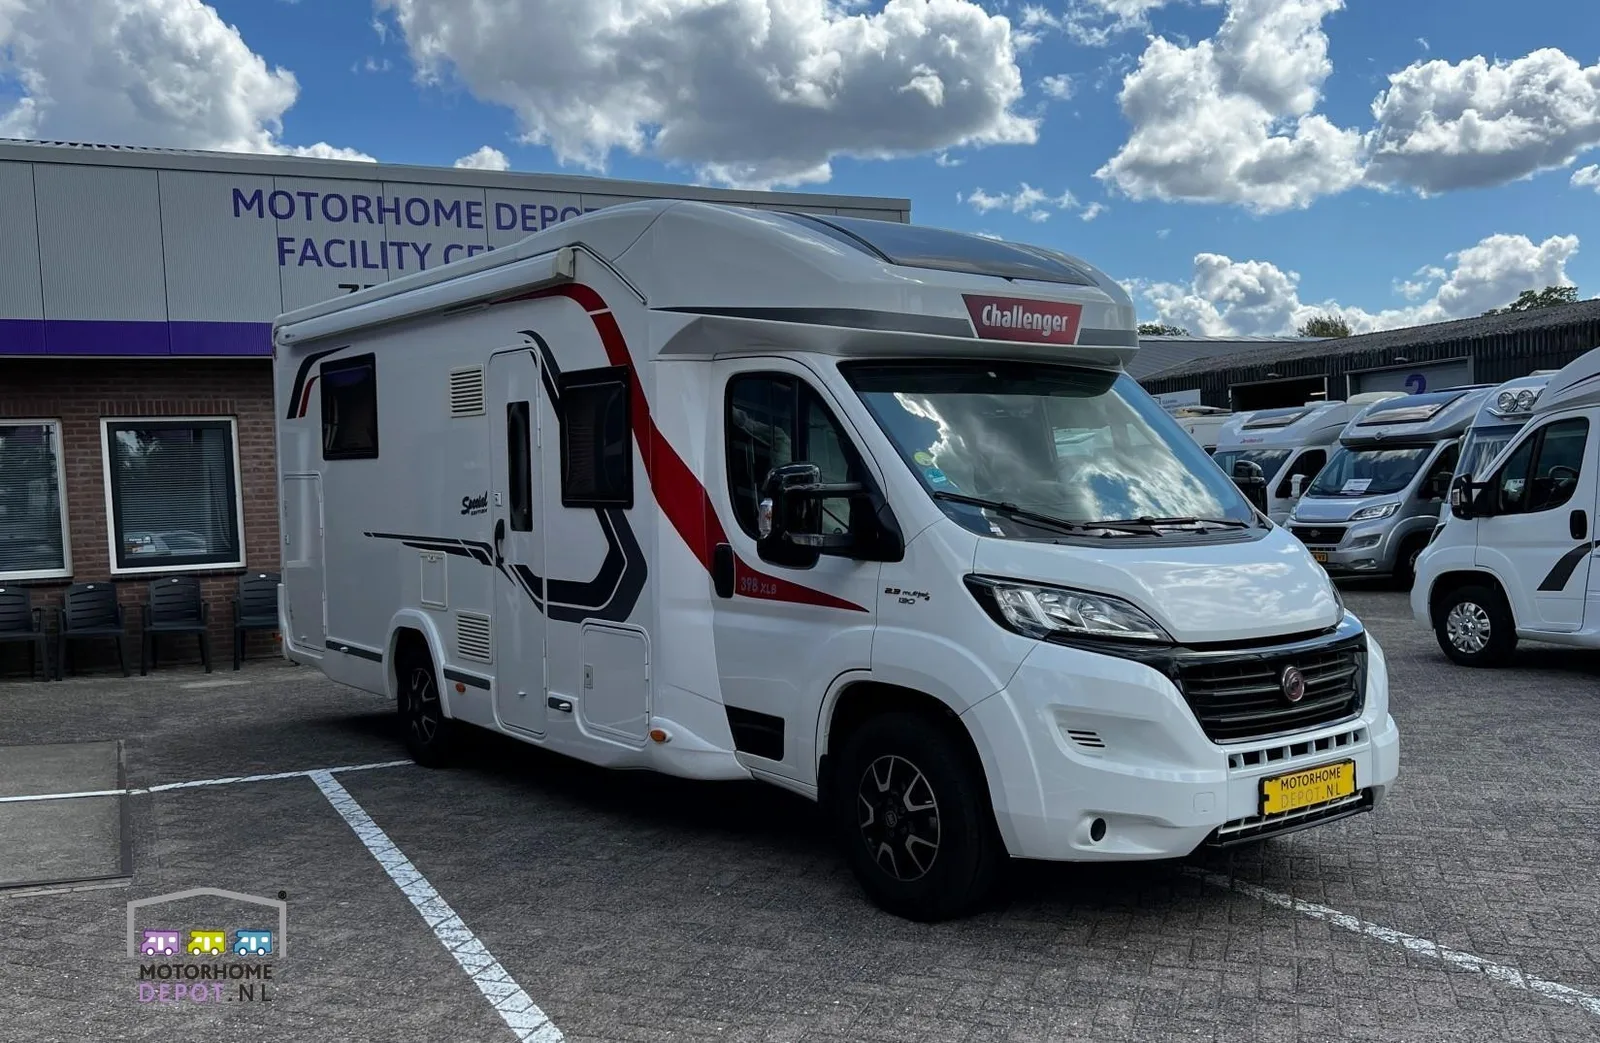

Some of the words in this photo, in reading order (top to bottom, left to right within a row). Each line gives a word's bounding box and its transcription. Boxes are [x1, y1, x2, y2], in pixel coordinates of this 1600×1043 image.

[232, 188, 484, 229] MOTORHOME
[495, 203, 600, 233] DEP
[277, 237, 432, 270] FACILITY
[982, 303, 1068, 337] Challenger
[1281, 767, 1341, 790] MOTORHOME
